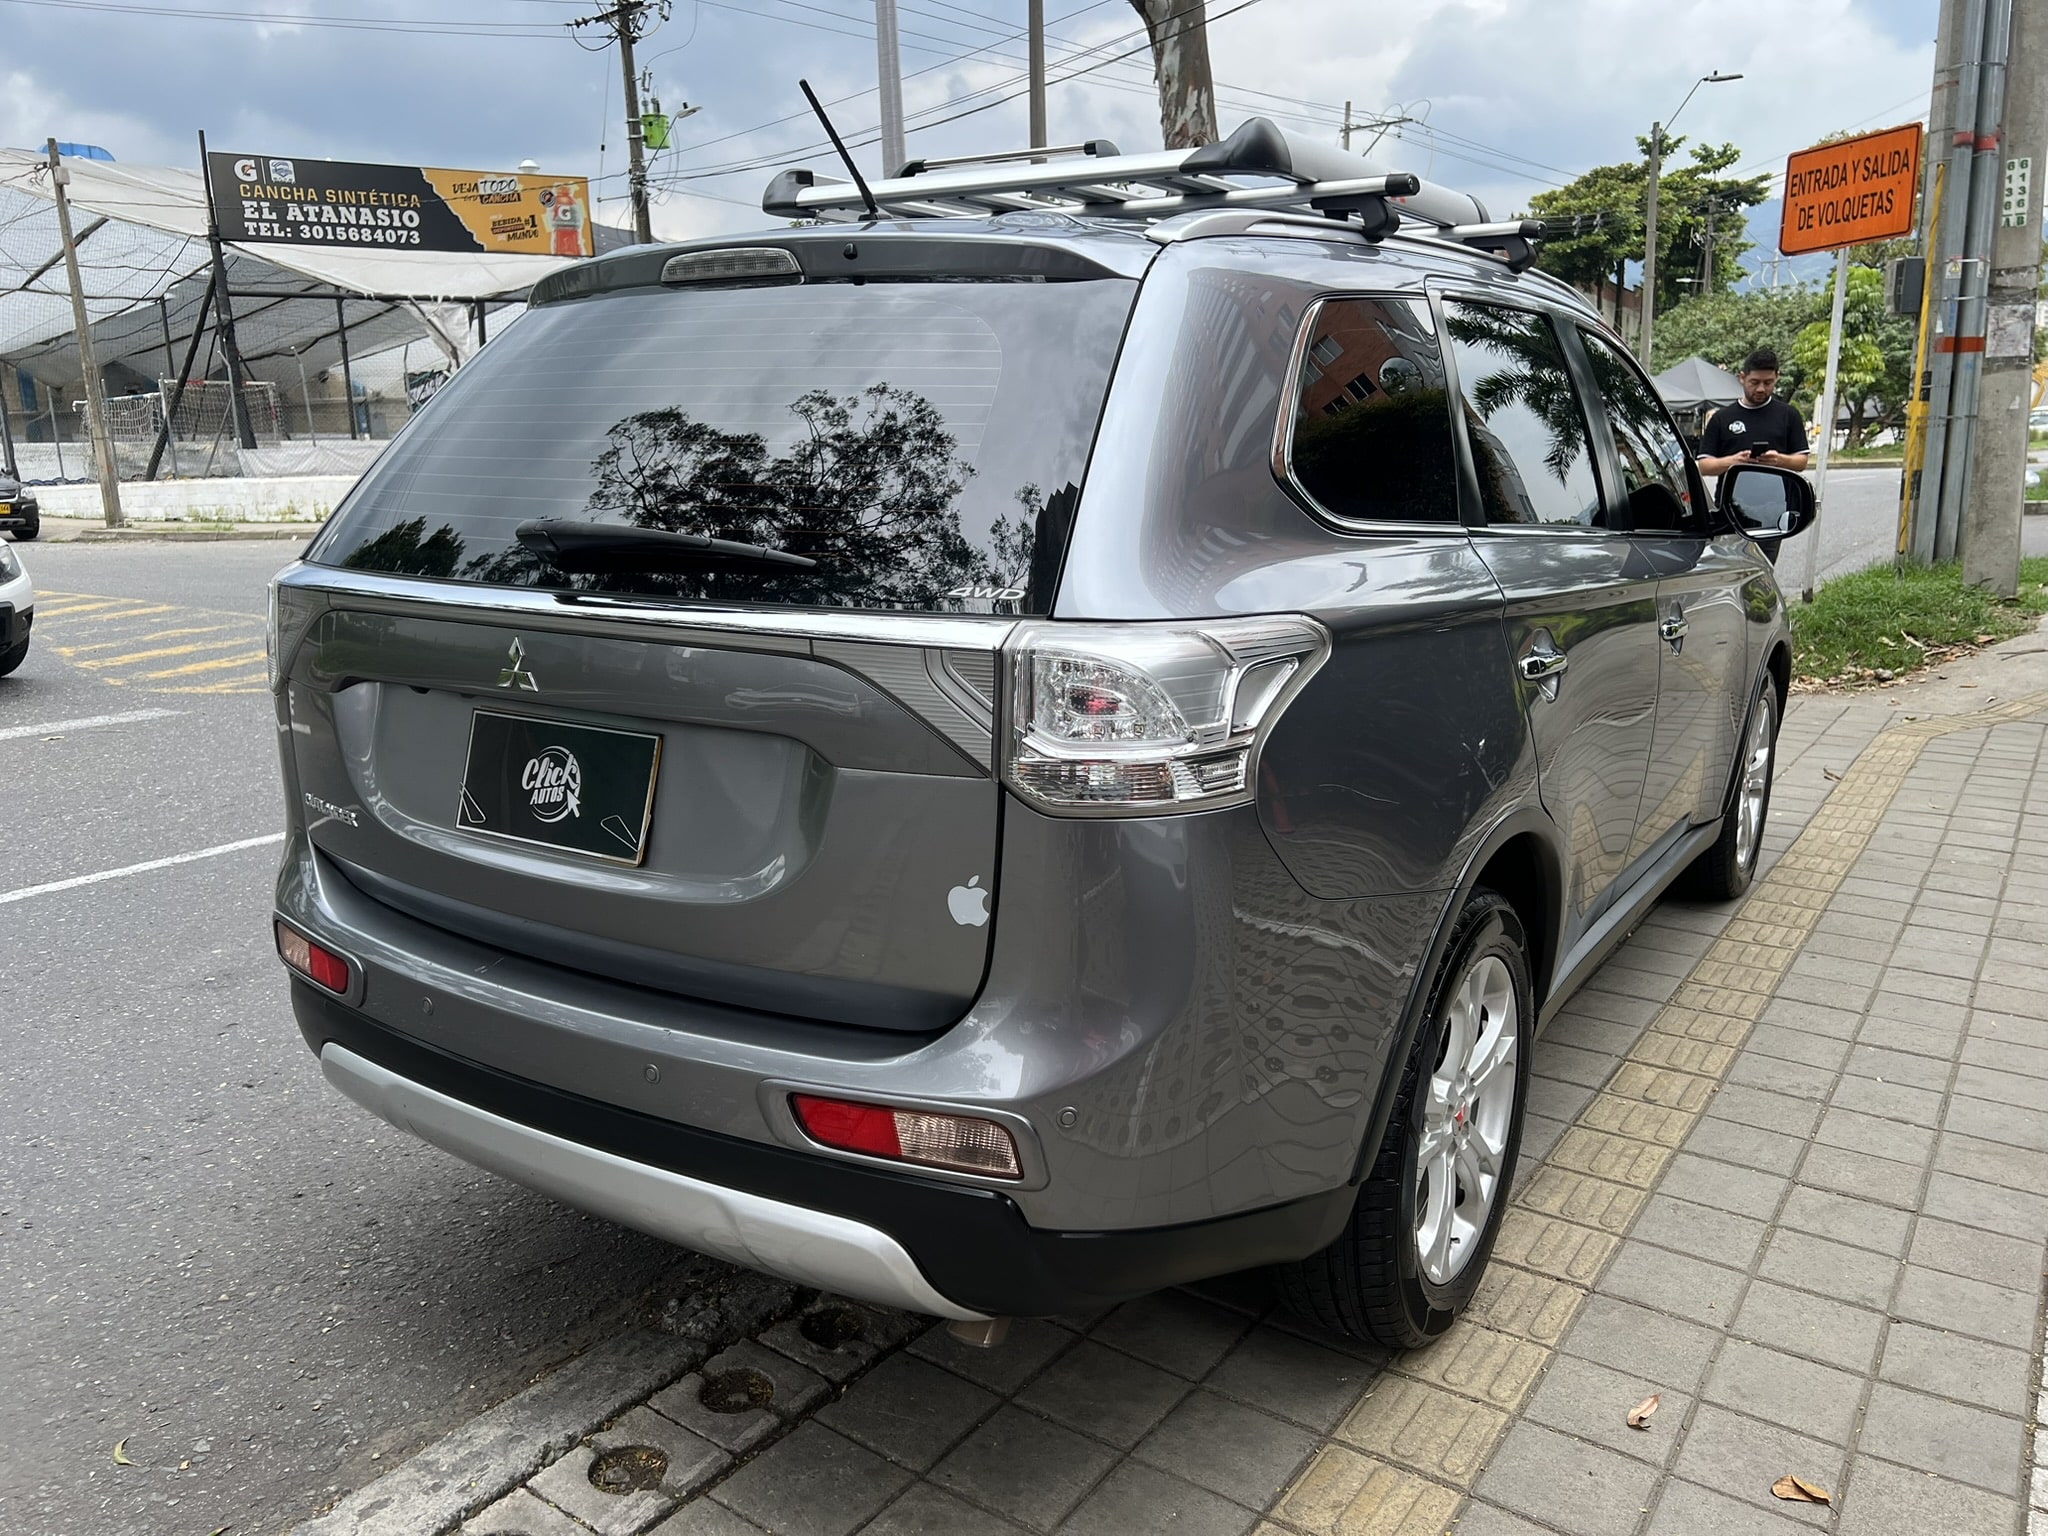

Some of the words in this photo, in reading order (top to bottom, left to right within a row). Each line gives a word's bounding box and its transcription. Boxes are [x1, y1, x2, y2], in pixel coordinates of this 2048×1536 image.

[1790, 162, 1848, 198] ENTRADA
[1852, 159, 1860, 184] Y
[1862, 147, 1910, 182] SALIDA
[239, 183, 319, 202] CANCHA
[325, 188, 421, 208] SINTÉTICA
[480, 178, 517, 193] TODO
[242, 200, 277, 220] EL
[286, 202, 420, 228] ATANASIO
[1798, 205, 1815, 231] DE
[1818, 188, 1894, 227] VOLQUETAS
[244, 221, 292, 238] TEL:
[299, 224, 421, 245] 3015684073
[947, 586, 1026, 600] 4WD
[521, 753, 579, 790] Click
[529, 785, 565, 805] AUTOS
